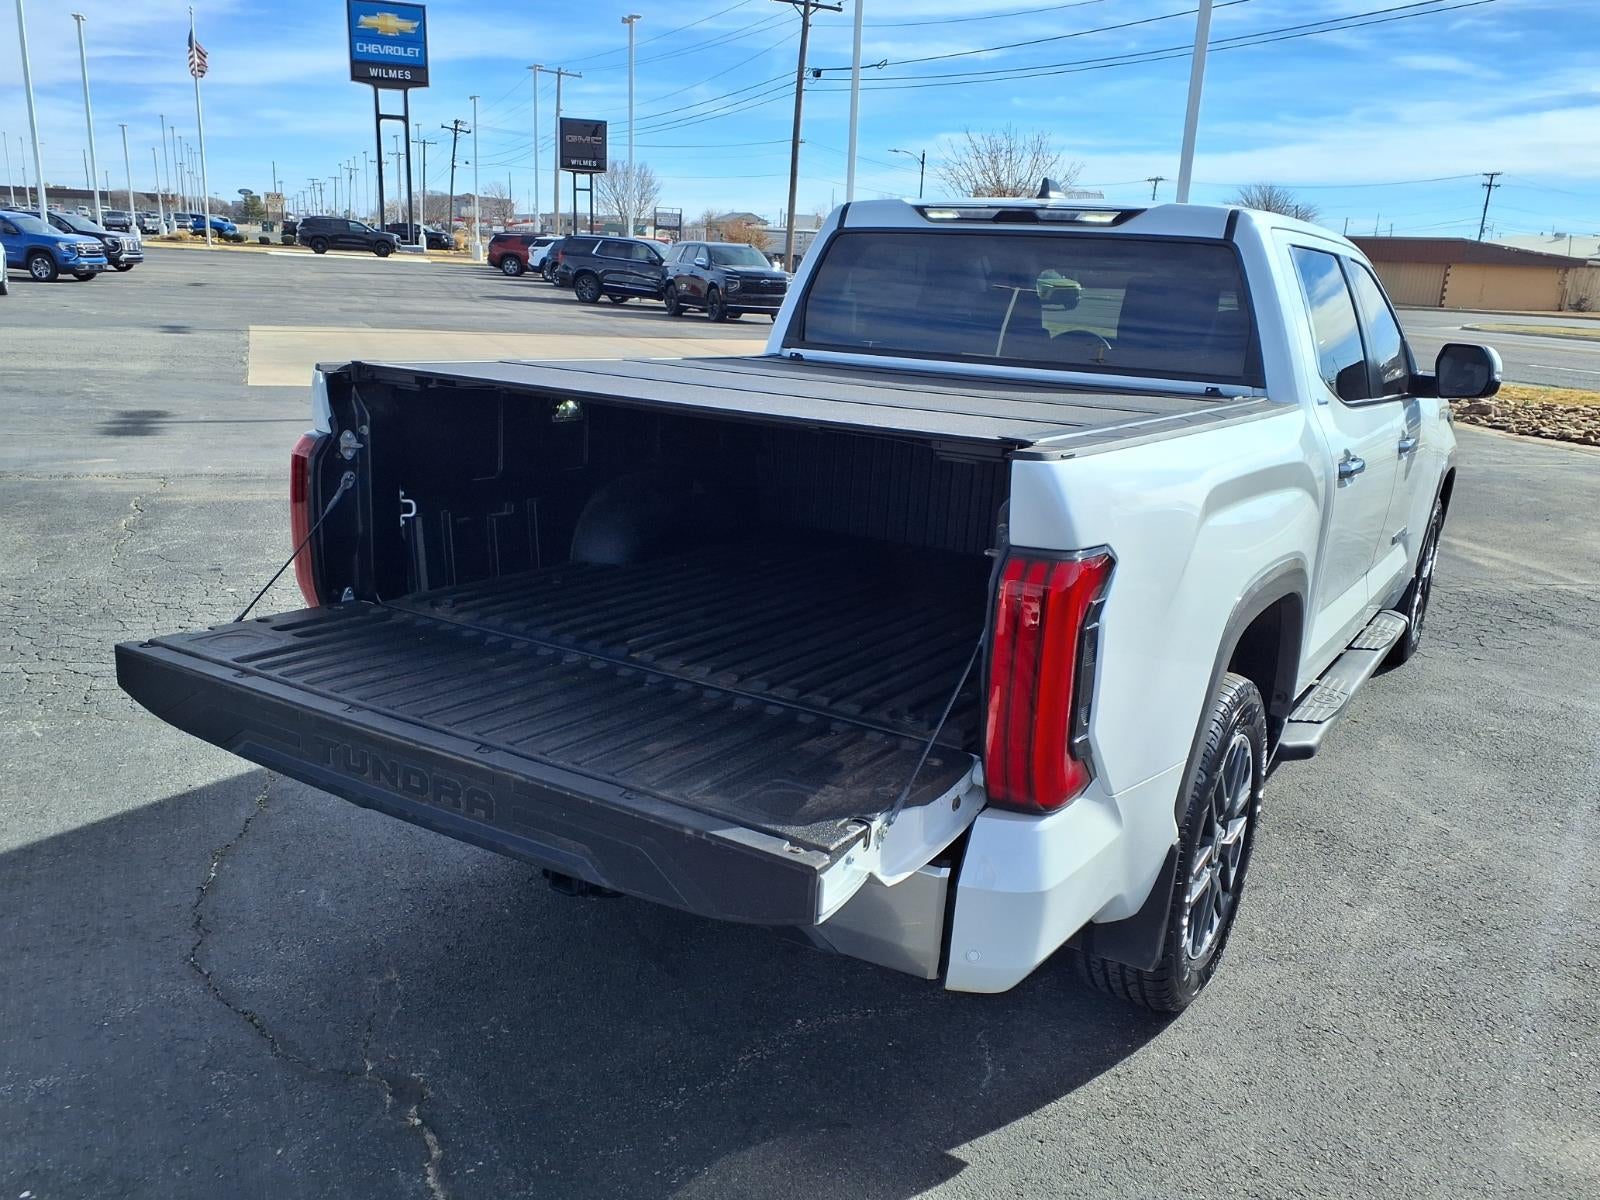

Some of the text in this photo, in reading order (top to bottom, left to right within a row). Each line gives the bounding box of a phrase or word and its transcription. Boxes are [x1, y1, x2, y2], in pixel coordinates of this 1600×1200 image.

[356, 42, 420, 58] CHEVROLET
[369, 67, 412, 80] WILMES
[565, 134, 603, 145] GMC
[570, 159, 597, 167] WILMES
[317, 737, 496, 822] TUNDRA
